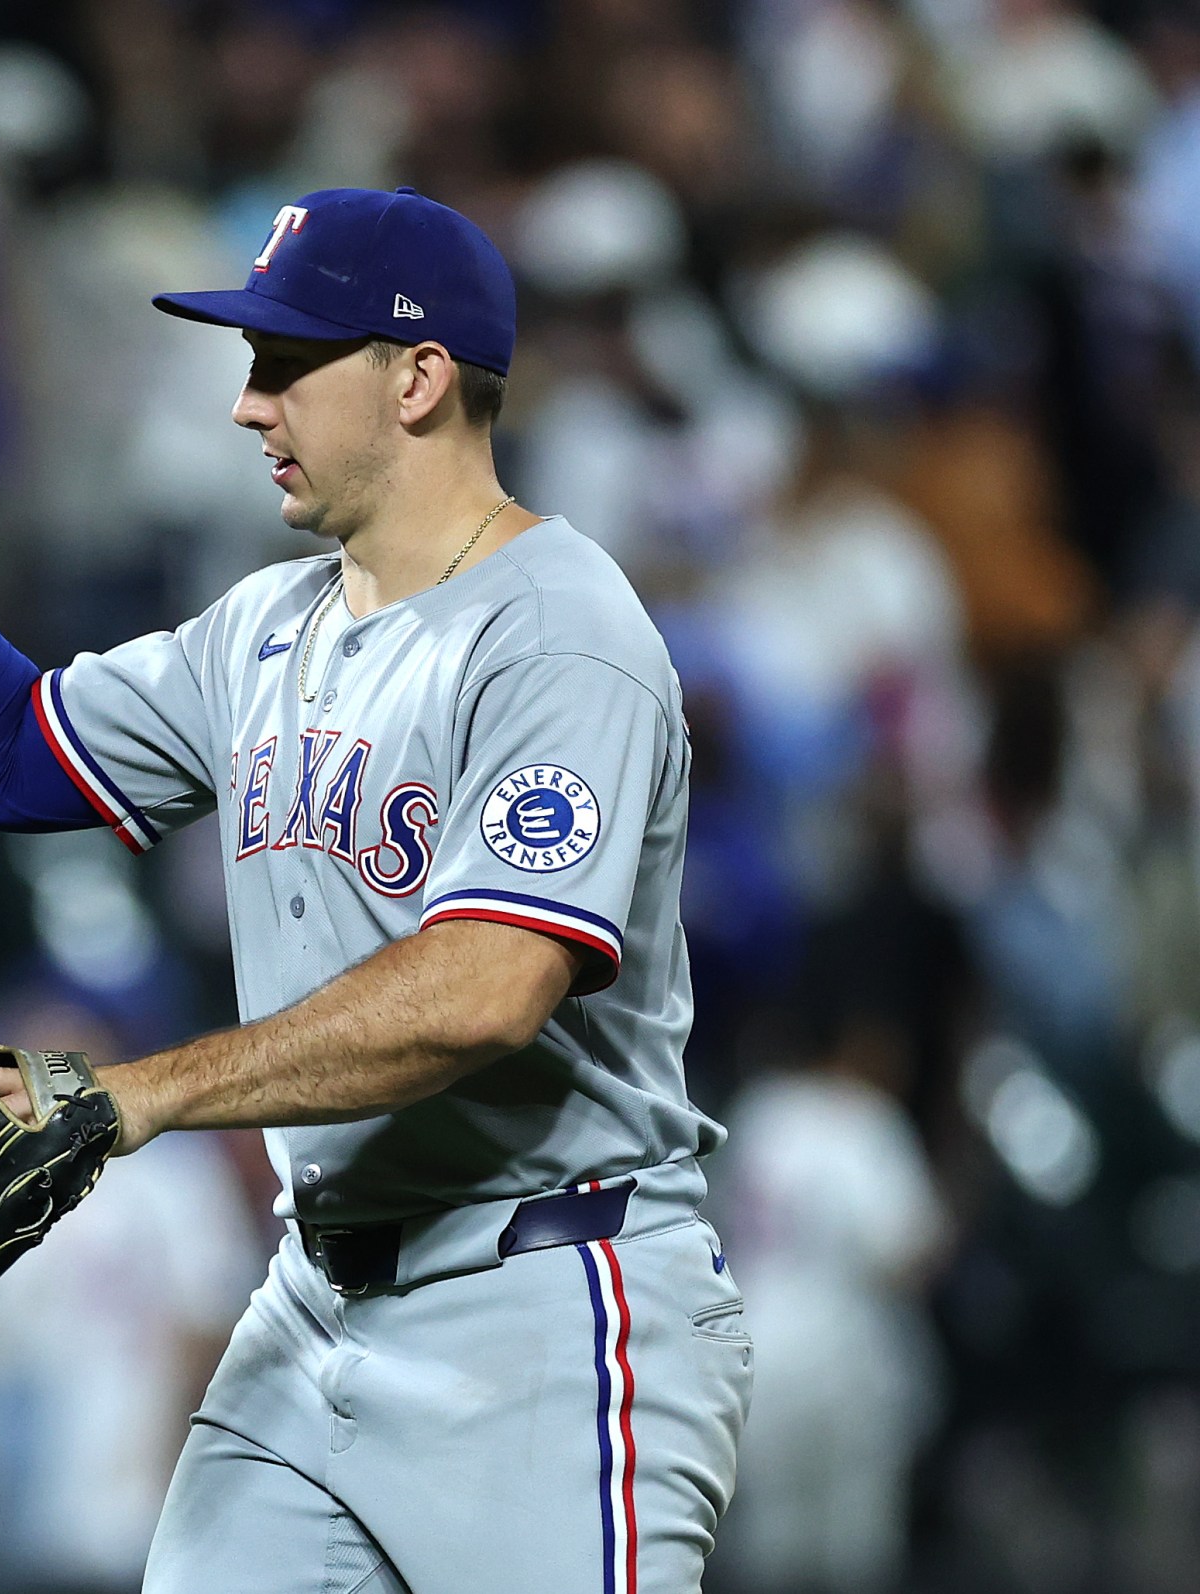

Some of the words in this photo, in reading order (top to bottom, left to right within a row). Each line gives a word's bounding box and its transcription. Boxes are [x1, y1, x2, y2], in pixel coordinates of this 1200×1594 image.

[254, 205, 309, 273] T
[230, 727, 439, 898] EXAS
[496, 768, 595, 811] ENERGY
[485, 819, 593, 868] TRANSFER
